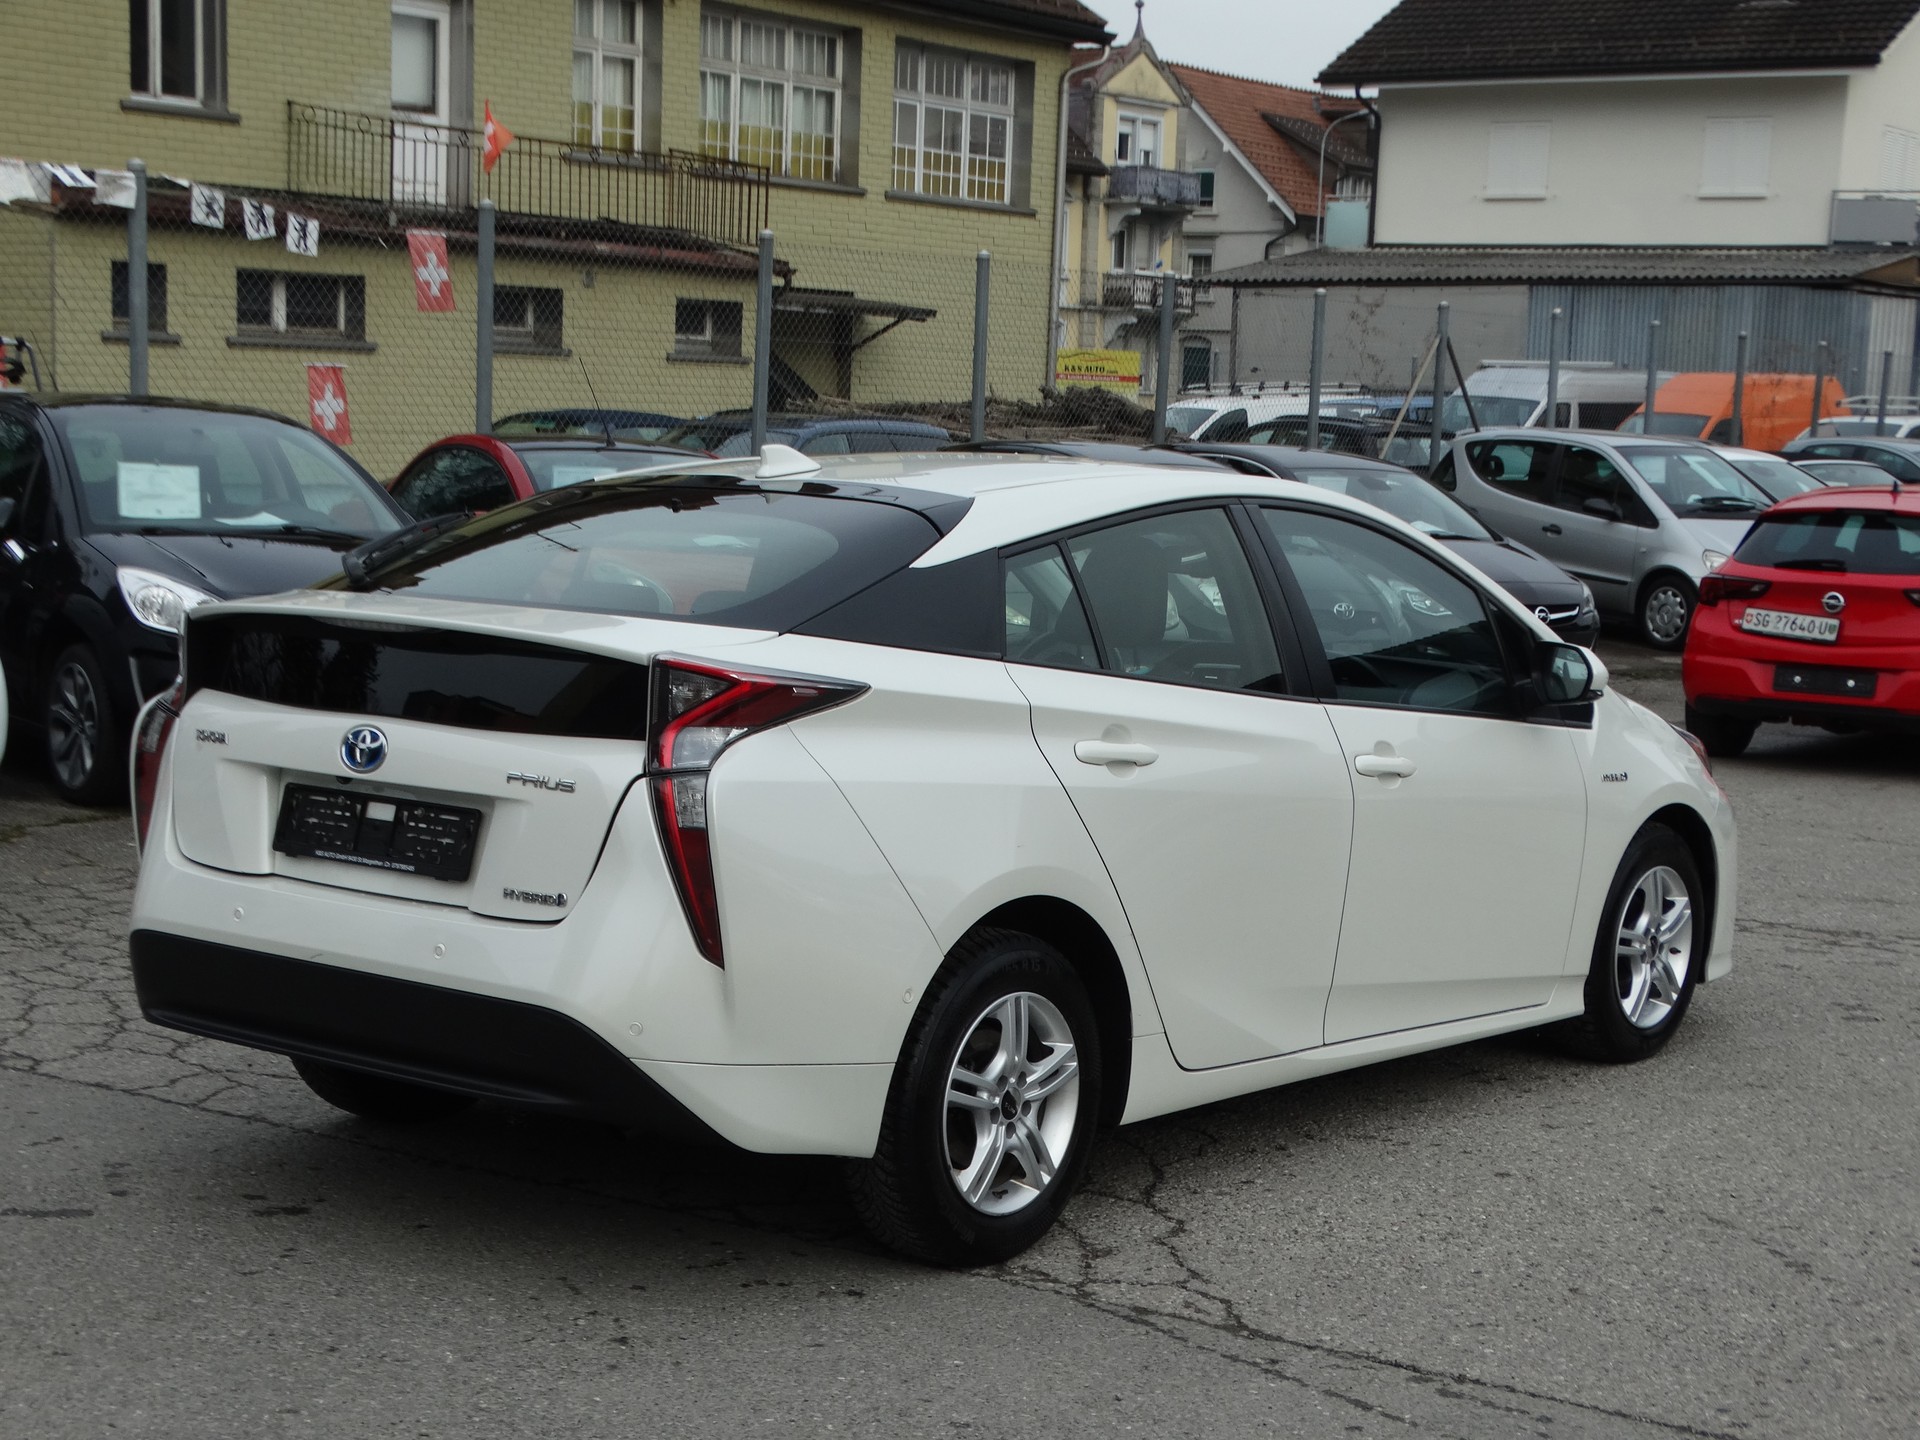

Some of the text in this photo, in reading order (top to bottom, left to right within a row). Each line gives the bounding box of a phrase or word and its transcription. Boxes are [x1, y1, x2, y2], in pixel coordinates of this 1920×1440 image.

[1084, 365, 1105, 373] AUTO
[1753, 612, 1771, 628] SG
[506, 771, 577, 793] PRIUS
[503, 888, 558, 907] HYBRID
